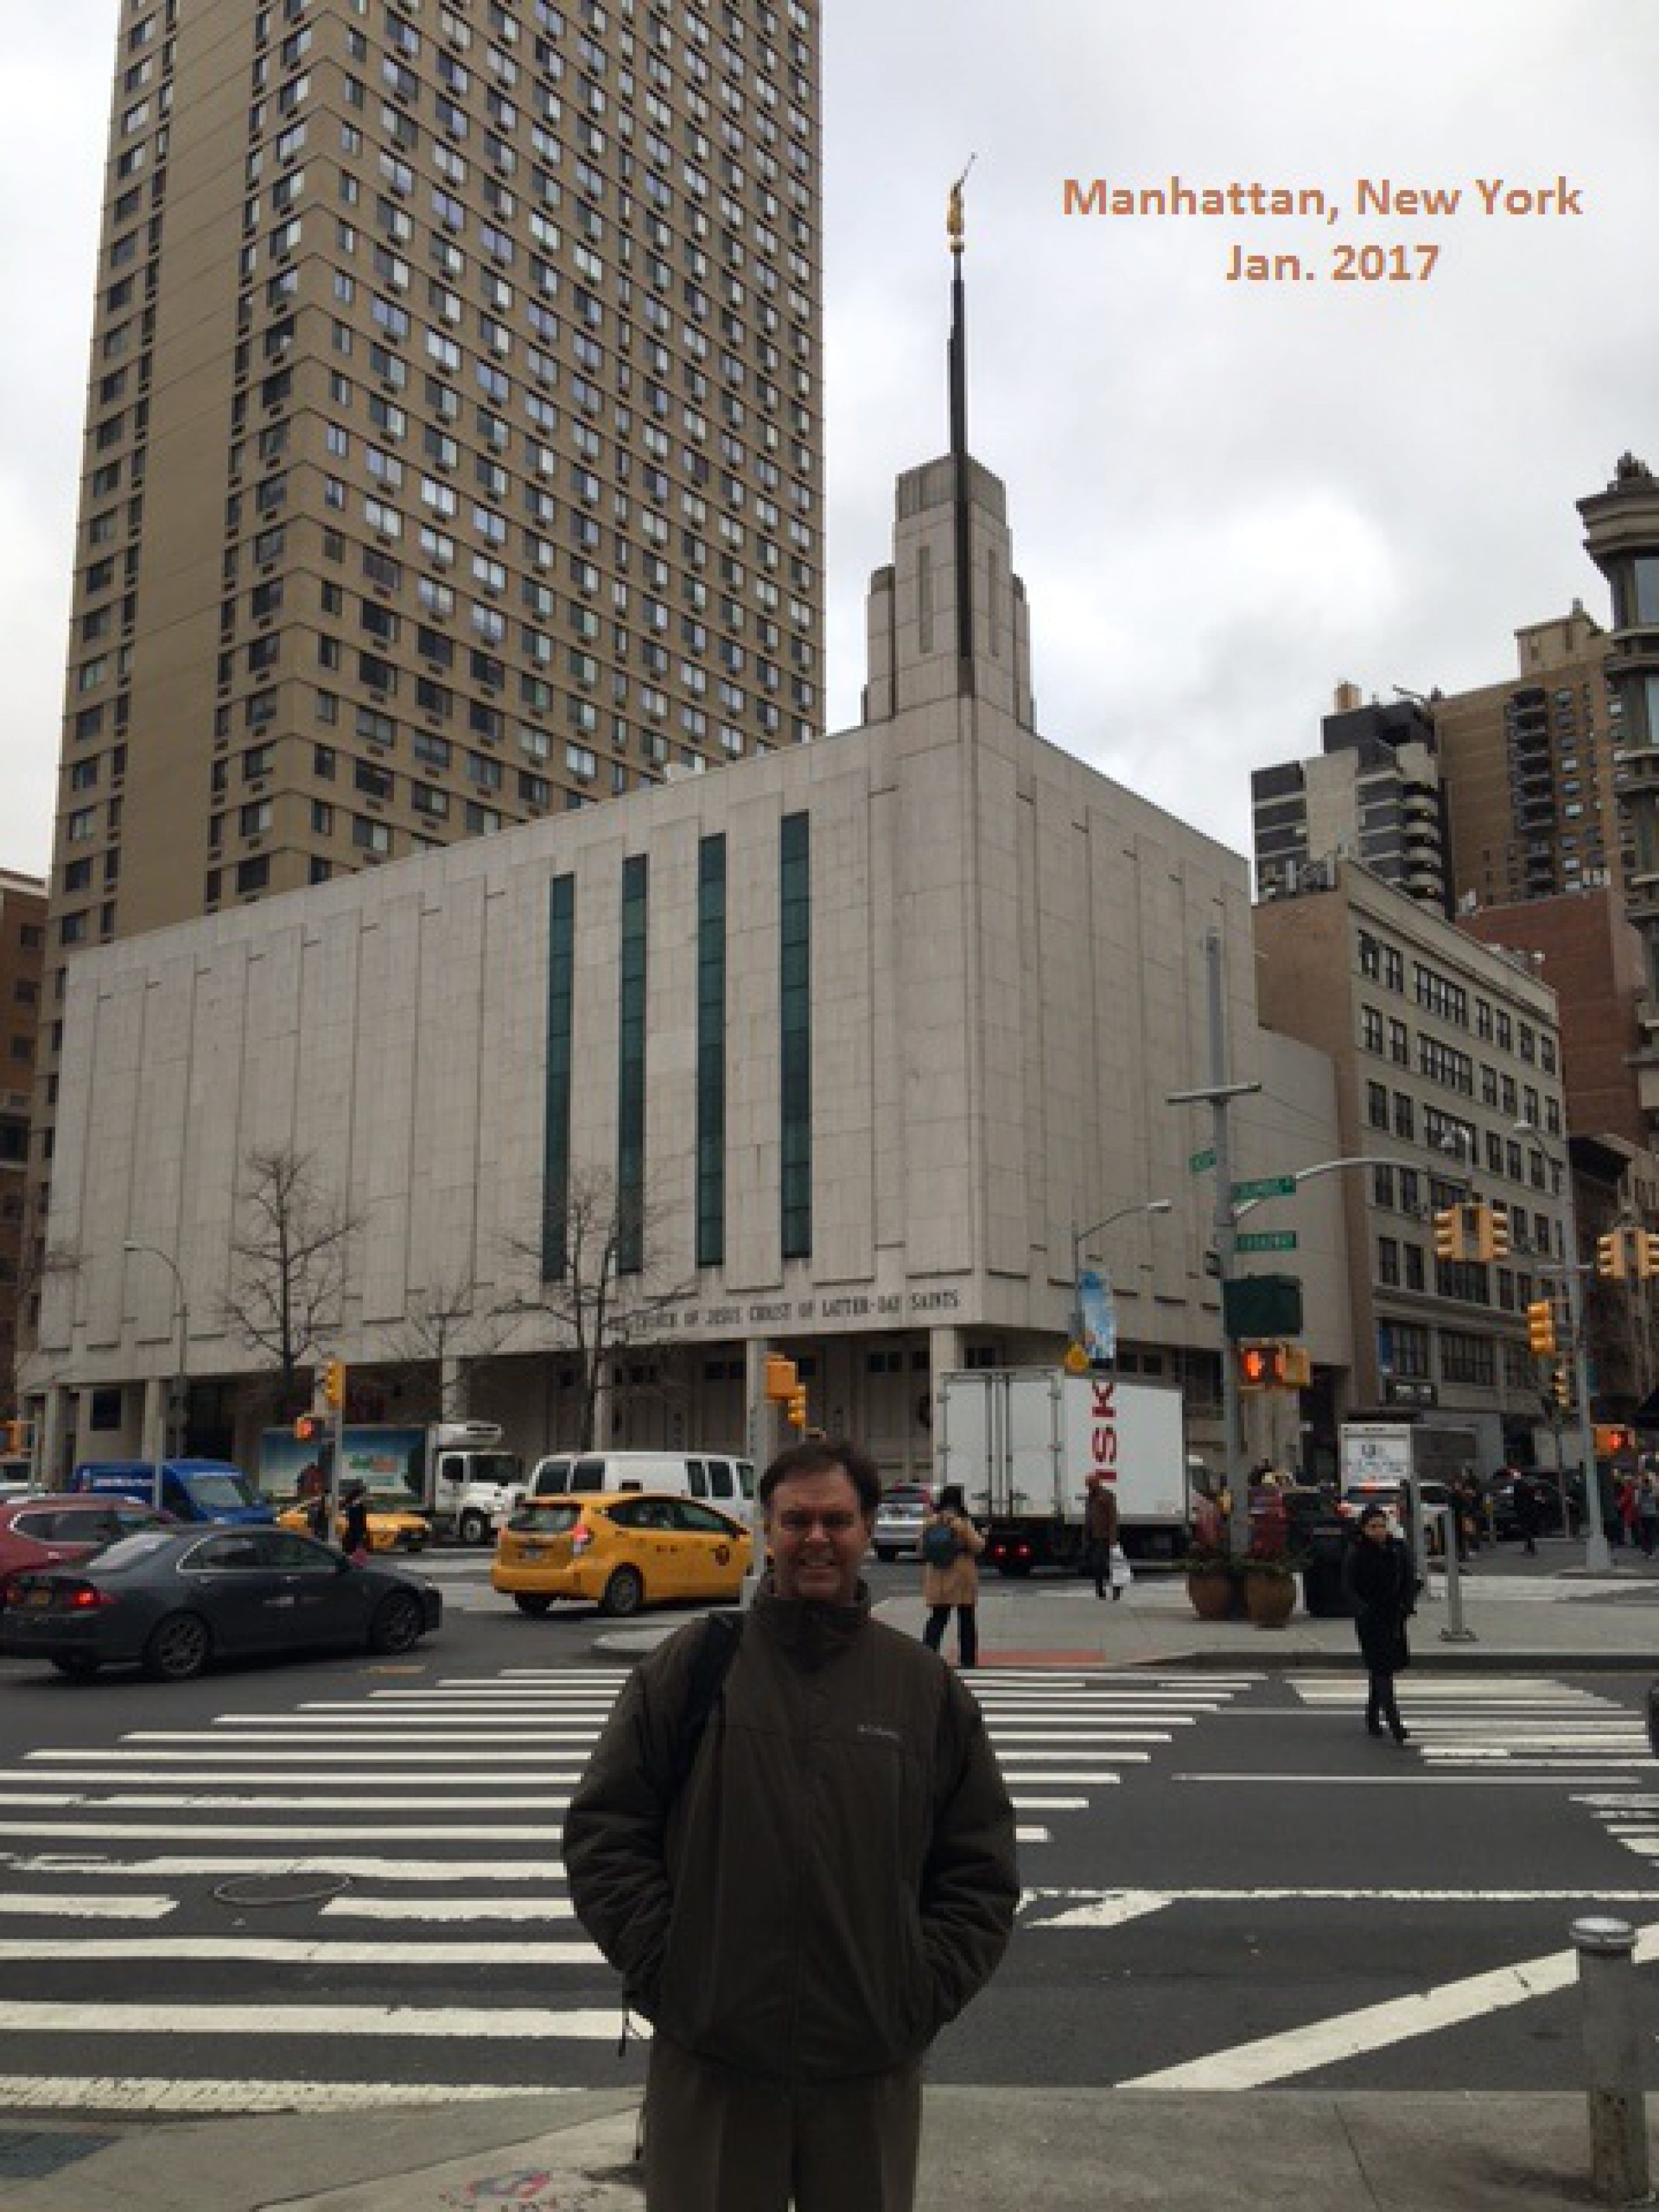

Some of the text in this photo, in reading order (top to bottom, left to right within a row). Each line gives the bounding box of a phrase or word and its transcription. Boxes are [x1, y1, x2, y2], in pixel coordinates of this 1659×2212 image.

[706, 1306, 741, 1325] JESUS
[748, 1302, 793, 1321] CHRIST
[798, 1299, 814, 1320] OF
[911, 1288, 960, 1310] SAINTS
